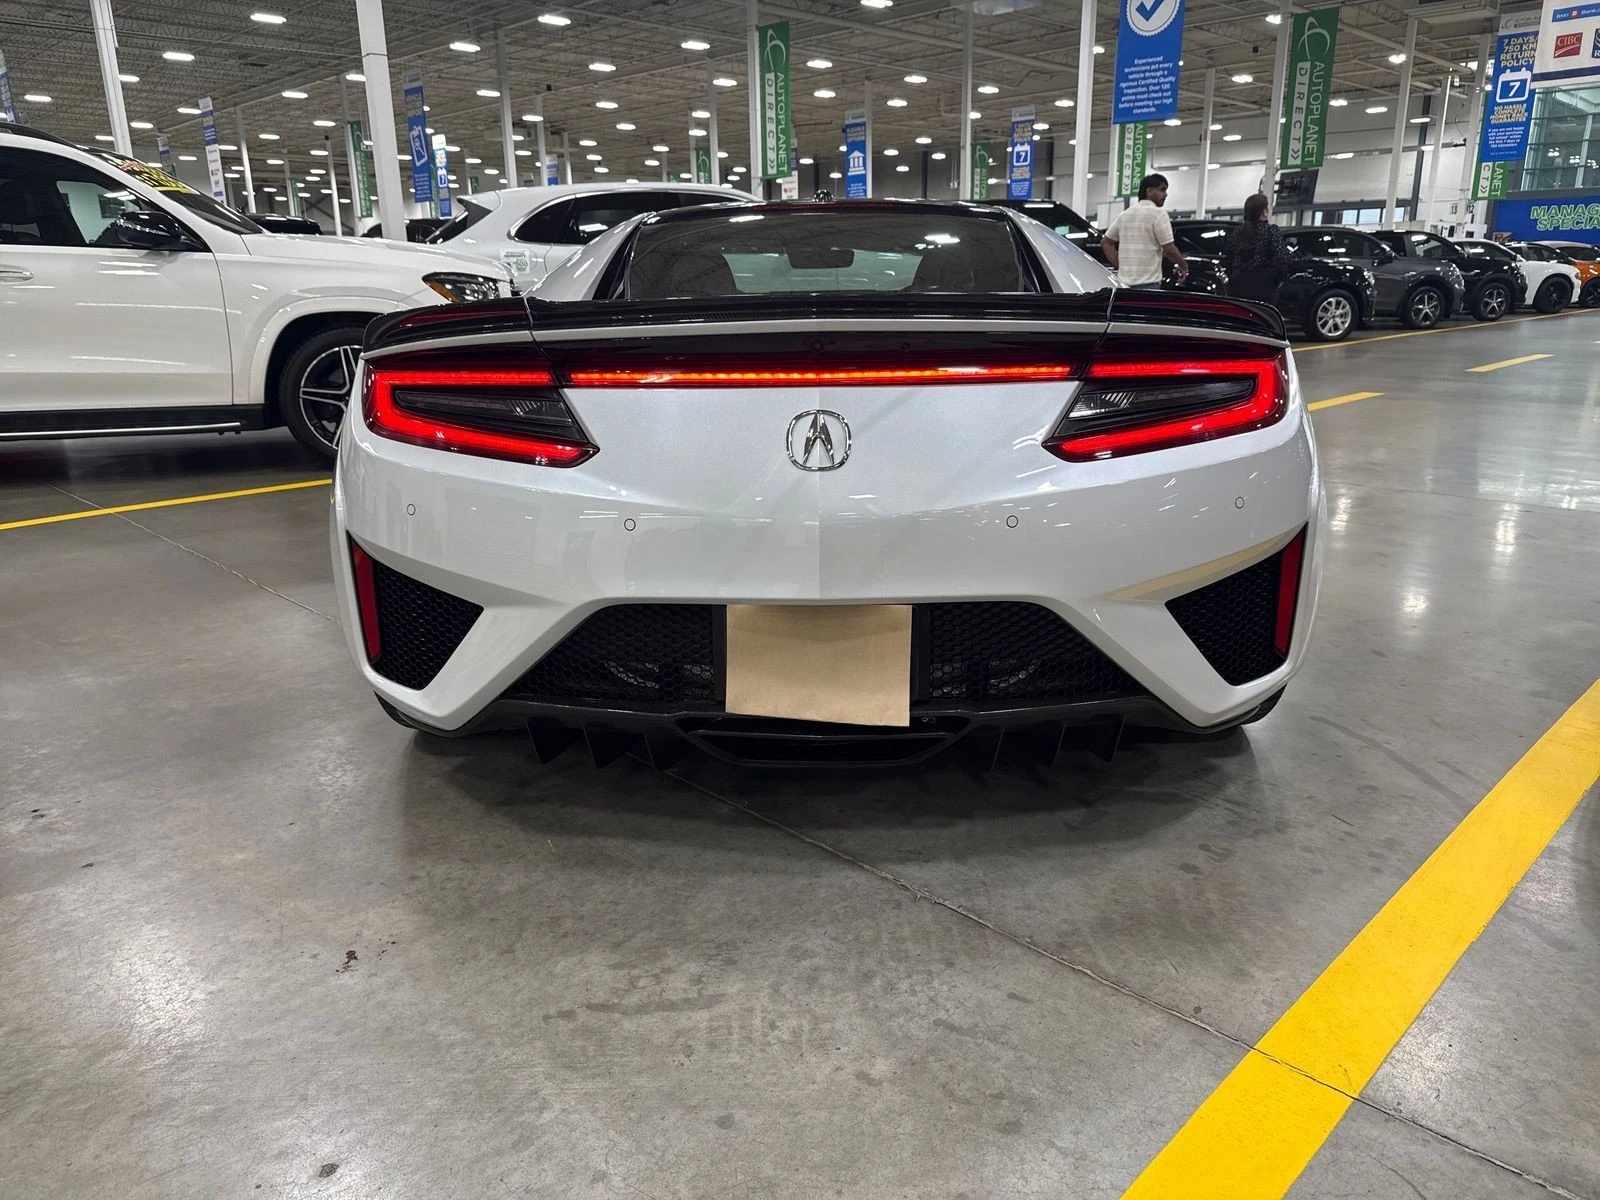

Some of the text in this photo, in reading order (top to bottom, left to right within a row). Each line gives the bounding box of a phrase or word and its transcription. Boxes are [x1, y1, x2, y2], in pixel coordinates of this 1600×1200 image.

[1504, 42, 1537, 53] 750 KM
[1557, 34, 1582, 47] CIBC
[1134, 56, 1163, 65] Experienced
[1500, 51, 1536, 61] RETURN
[1501, 58, 1534, 68] POLICY
[1509, 82, 1520, 97] 7
[1293, 67, 1308, 143] DIRECT
[1304, 61, 1325, 164] AUTOPLANET
[767, 78, 775, 153] DIRECT
[777, 72, 788, 173] AUTOPLANET
[1019, 152, 1026, 162] 7
[1124, 127, 1132, 180] DIRECT
[1132, 123, 1144, 193] AUTOPLANET
[1530, 203, 1600, 219] MANAG
[1537, 215, 1600, 231] SPECIA
